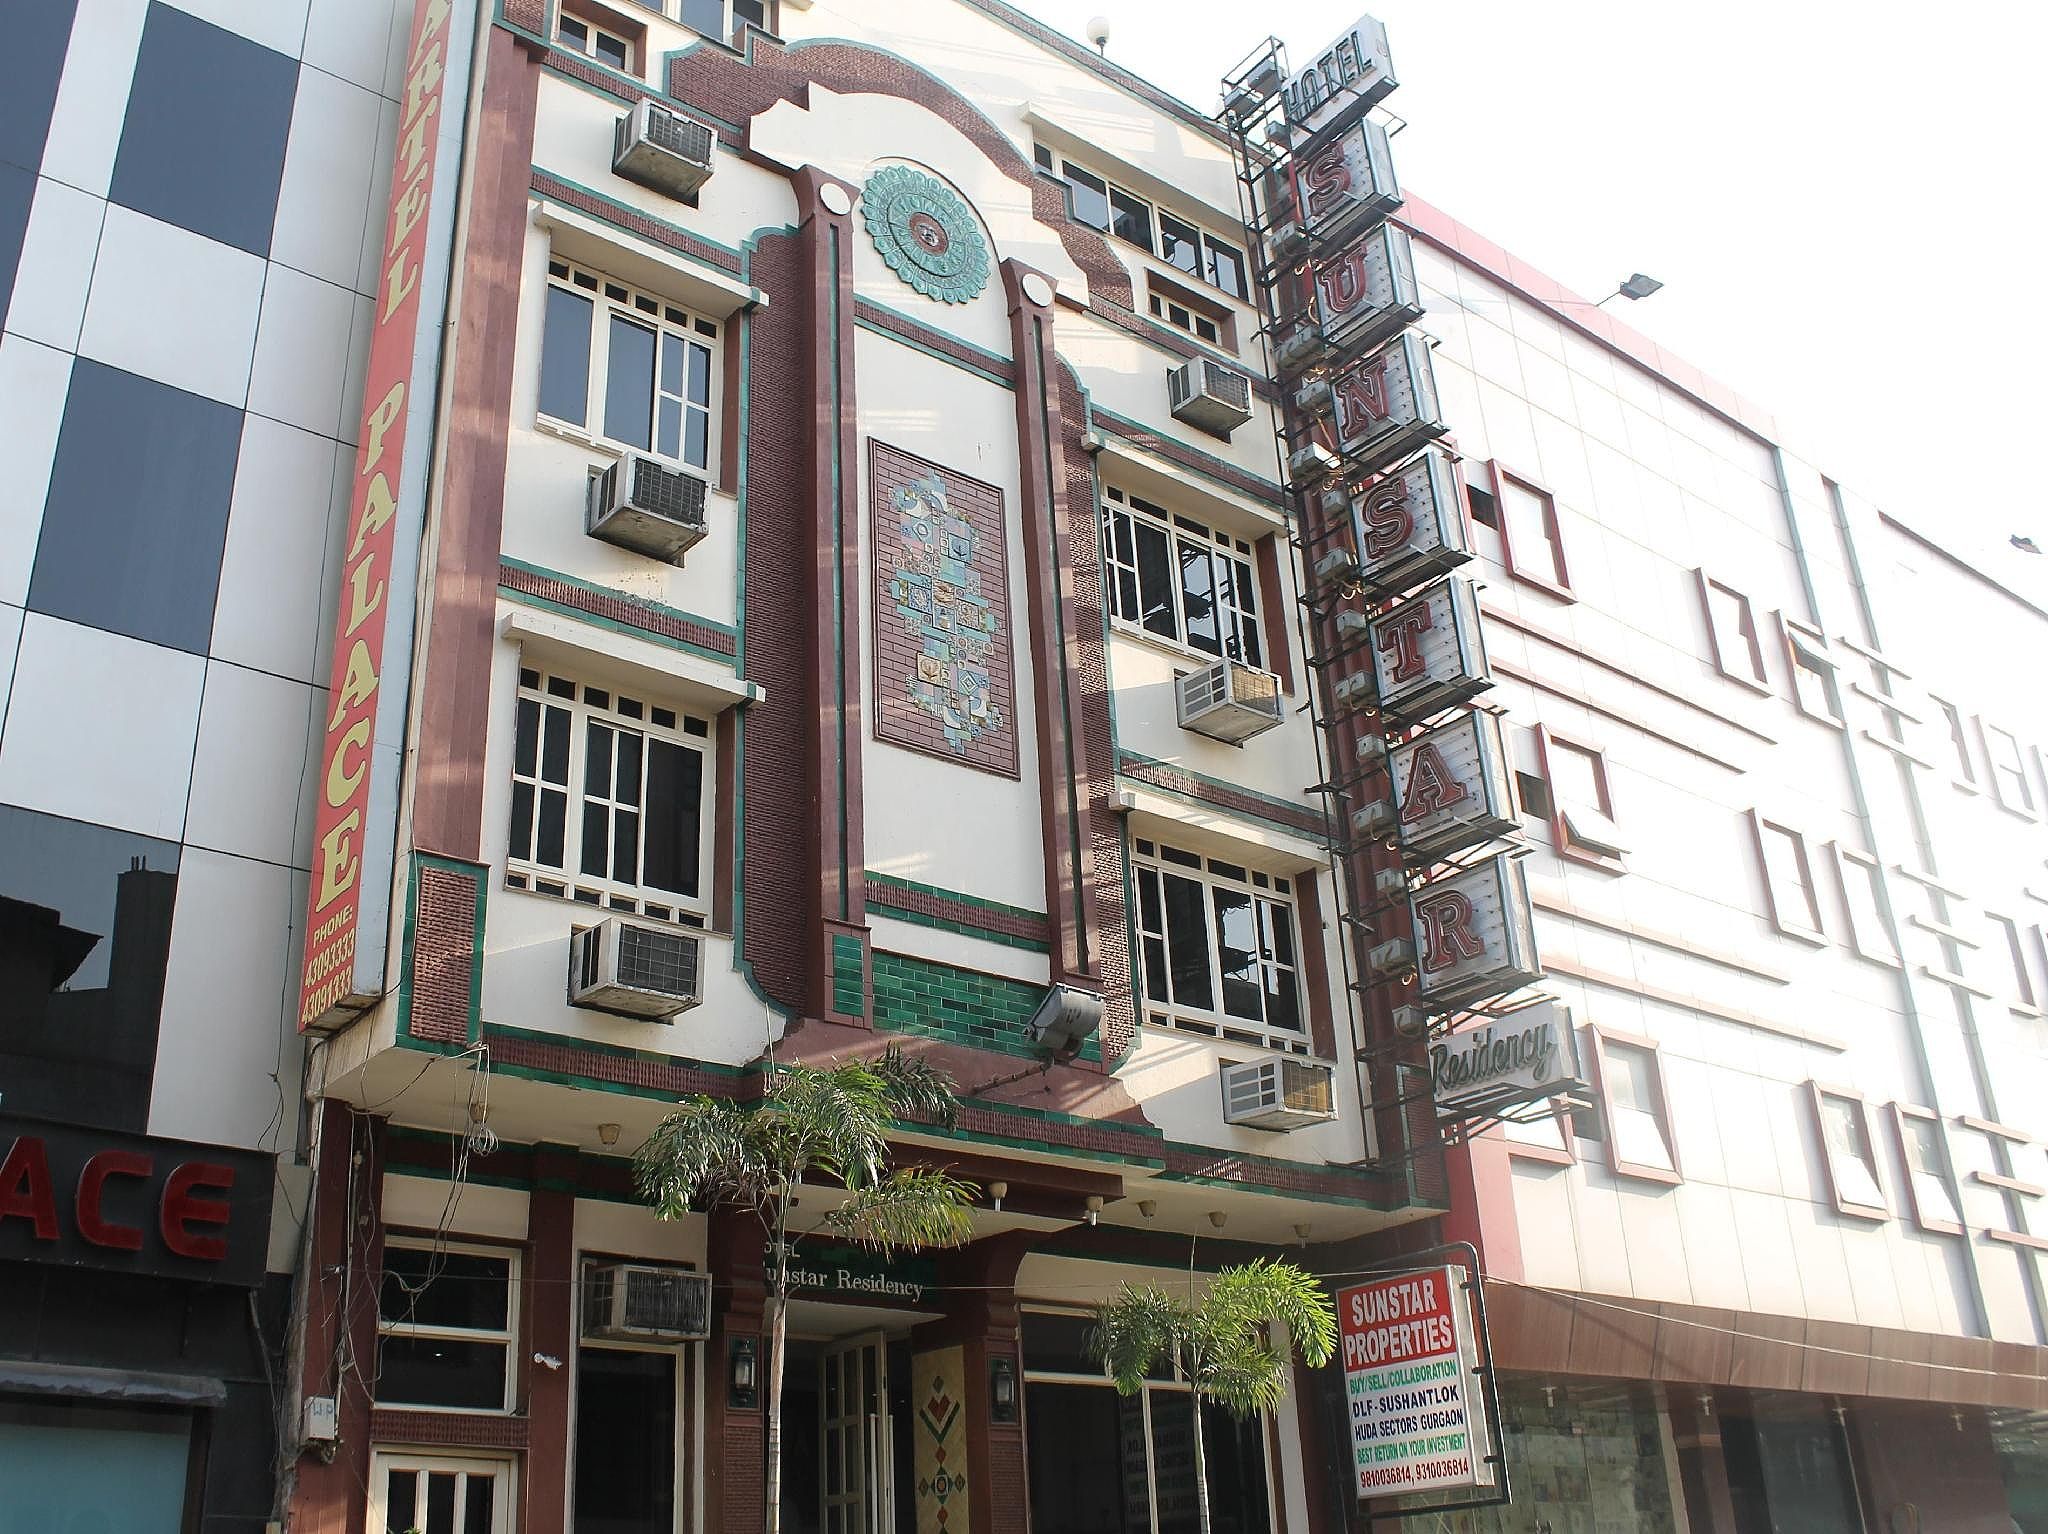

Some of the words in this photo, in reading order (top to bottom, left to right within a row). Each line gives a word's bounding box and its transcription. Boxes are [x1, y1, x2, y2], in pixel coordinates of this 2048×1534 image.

[1281, 30, 1376, 123] HOTEL
[315, 380, 406, 913] PALACE
[313, 904, 353, 948] PHONE:
[305, 927, 355, 988] 43093333
[302, 965, 352, 1024] 43091333
[1429, 1023, 1557, 1096] Residency
[0, 1136, 235, 1260] ACE
[836, 1269, 923, 1304] Residency
[1351, 1279, 1437, 1327] SUNSTAR
[1344, 1315, 1452, 1367] PROPERTIES
[1354, 1422, 1378, 1441] HUDA
[1379, 1415, 1418, 1437] SECTORS
[1421, 1408, 1464, 1430] GURGAON
[1357, 1446, 1374, 1465] BEST
[1360, 1465, 1415, 1486] 9810036814,
[1416, 1457, 1469, 1480] 9310036814
